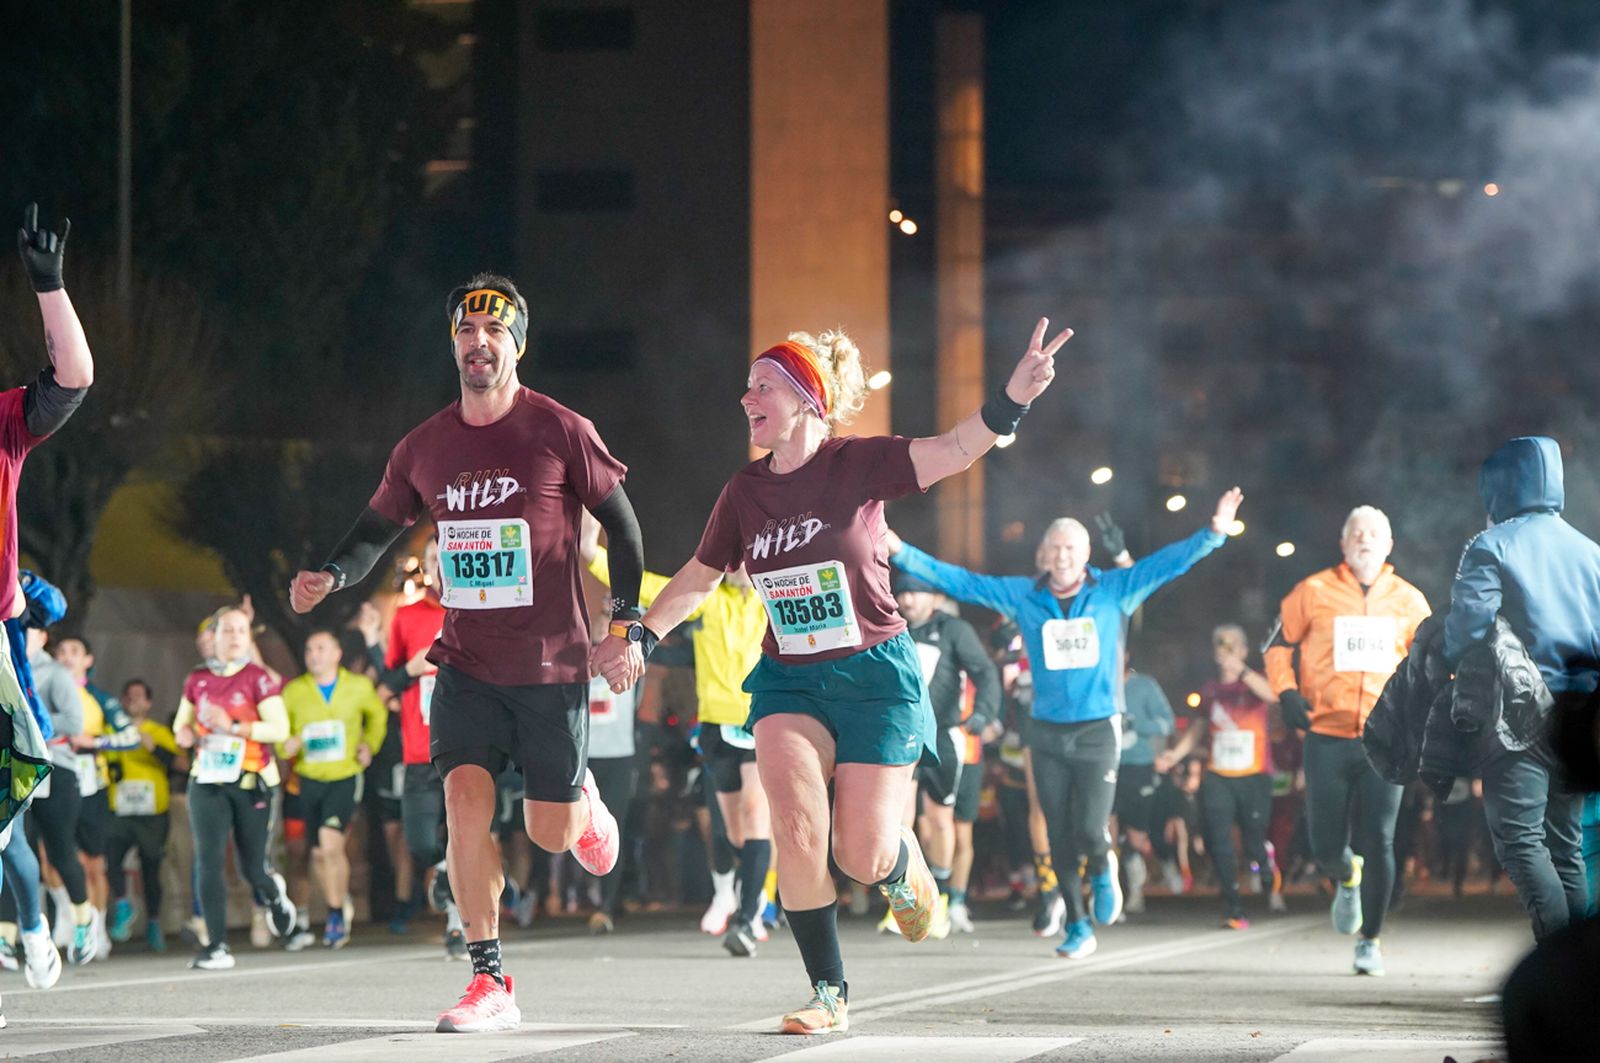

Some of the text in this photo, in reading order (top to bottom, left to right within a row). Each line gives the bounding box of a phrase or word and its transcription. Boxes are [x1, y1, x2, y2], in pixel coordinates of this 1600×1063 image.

[464, 293, 511, 322] UFF
[446, 476, 520, 512] WILD
[447, 541, 463, 550] SAN
[464, 539, 492, 550] ANTÓN
[456, 530, 479, 539] NOCHE
[481, 529, 492, 538] DE
[752, 518, 823, 561] WILD
[450, 551, 514, 579] 13317
[769, 590, 785, 599] SAN
[786, 586, 813, 598] ANTÓN
[773, 578, 797, 588] NOCHE
[799, 575, 811, 585] DE
[775, 592, 843, 626] 13583
